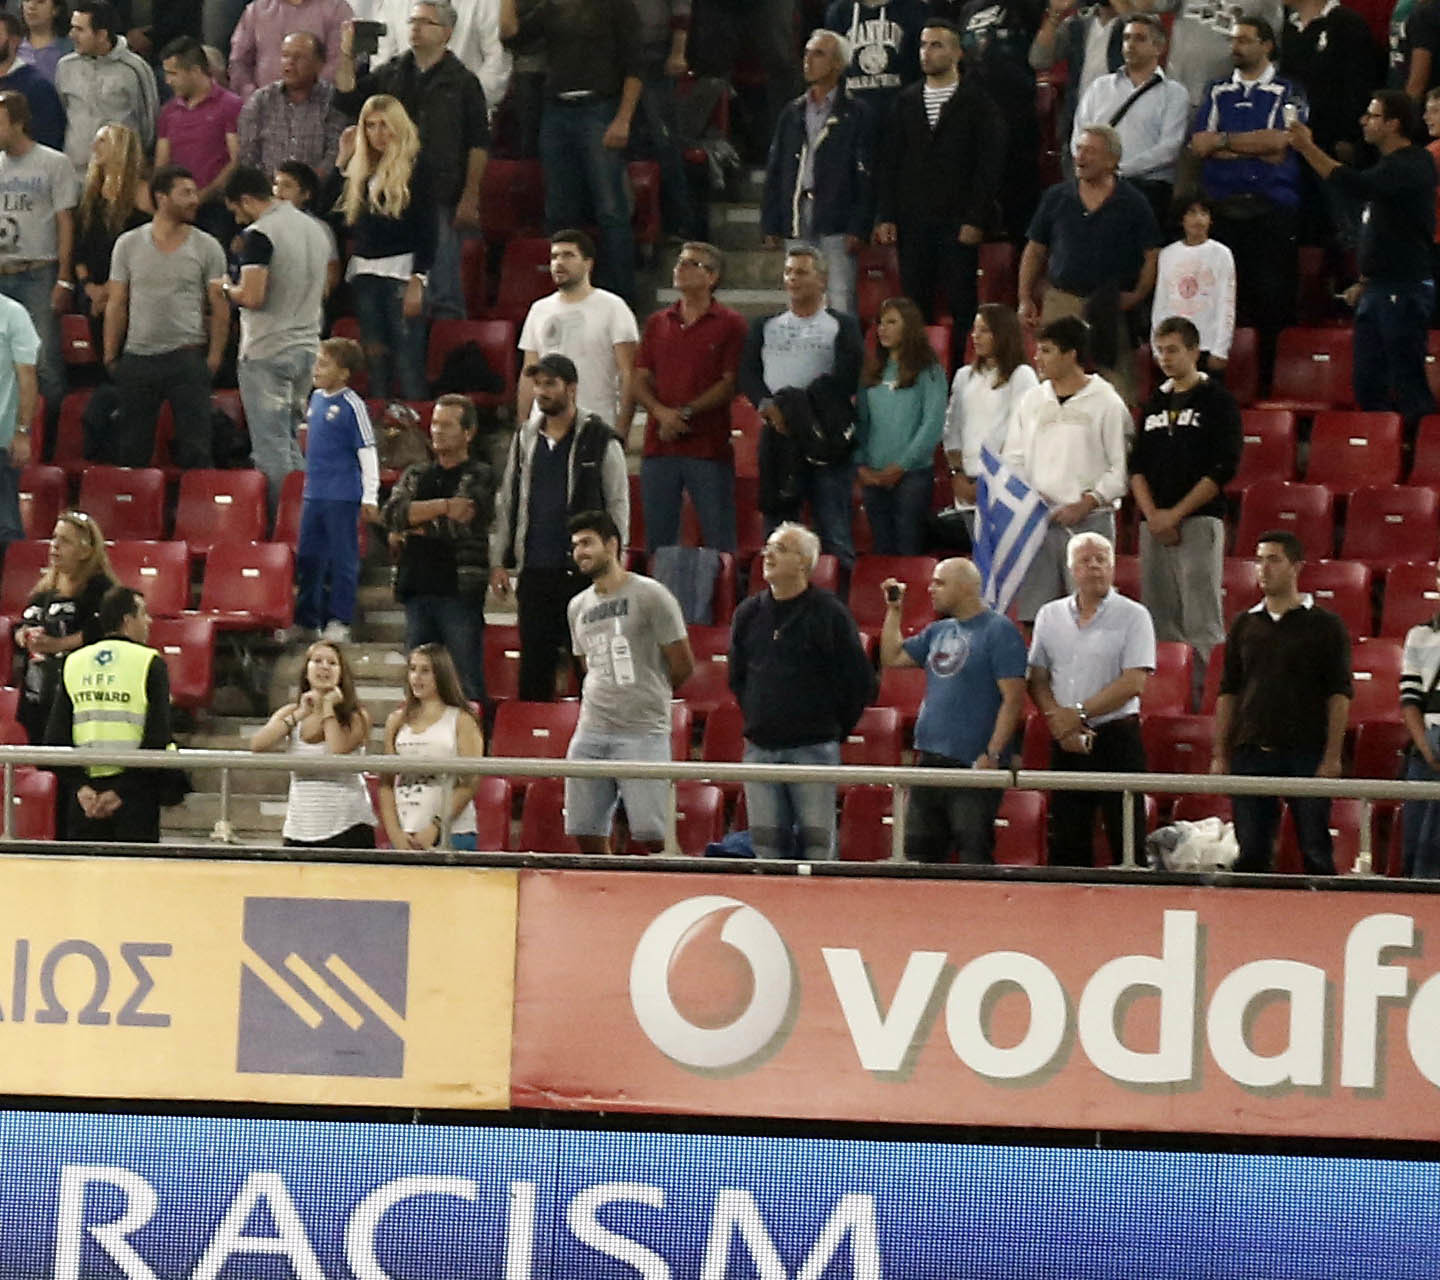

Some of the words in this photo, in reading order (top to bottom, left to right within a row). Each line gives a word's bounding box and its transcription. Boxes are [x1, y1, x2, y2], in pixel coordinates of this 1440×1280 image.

[3, 192, 33, 211] Life
[822, 909, 1440, 1089] vodaf
[53, 1162, 883, 1280] RACISM
